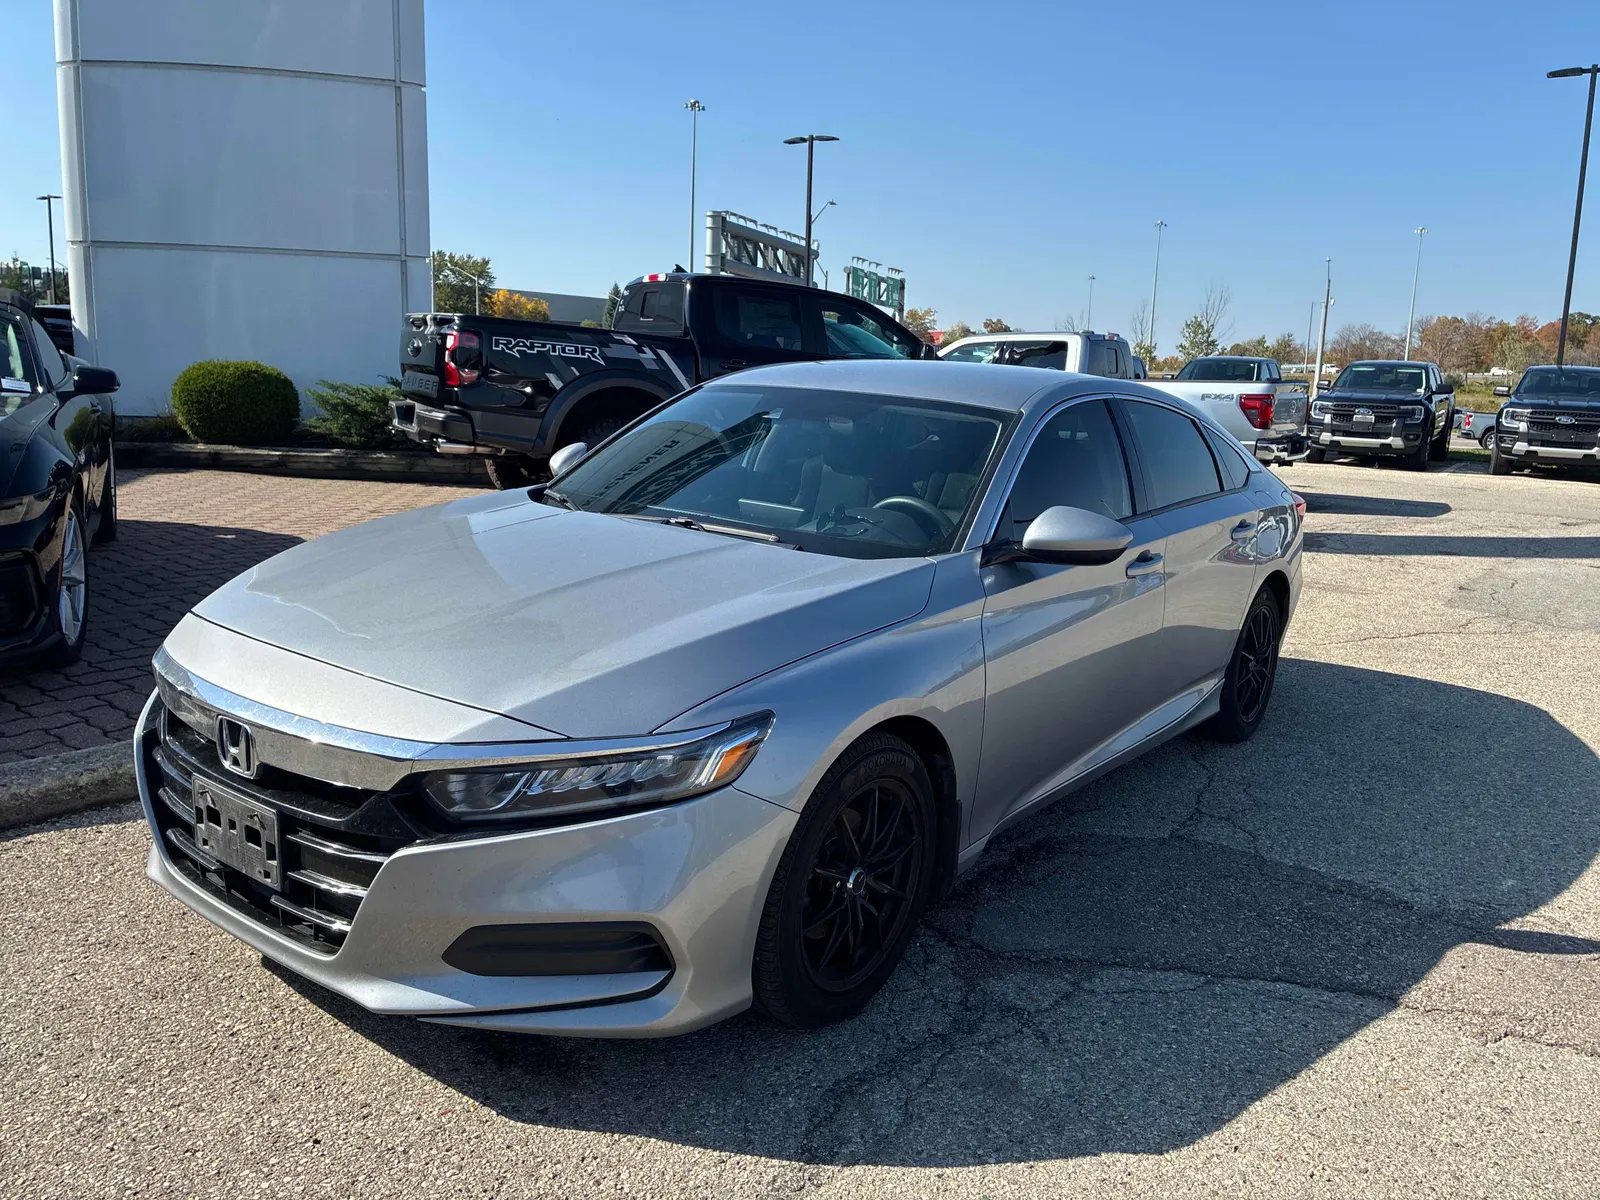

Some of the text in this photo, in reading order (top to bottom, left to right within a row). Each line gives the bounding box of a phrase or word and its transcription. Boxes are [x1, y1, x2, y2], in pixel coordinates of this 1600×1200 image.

[493, 337, 605, 365] RAPTOR
[1200, 393, 1234, 401] FX4
[863, 754, 907, 770] YOKOHAMA
